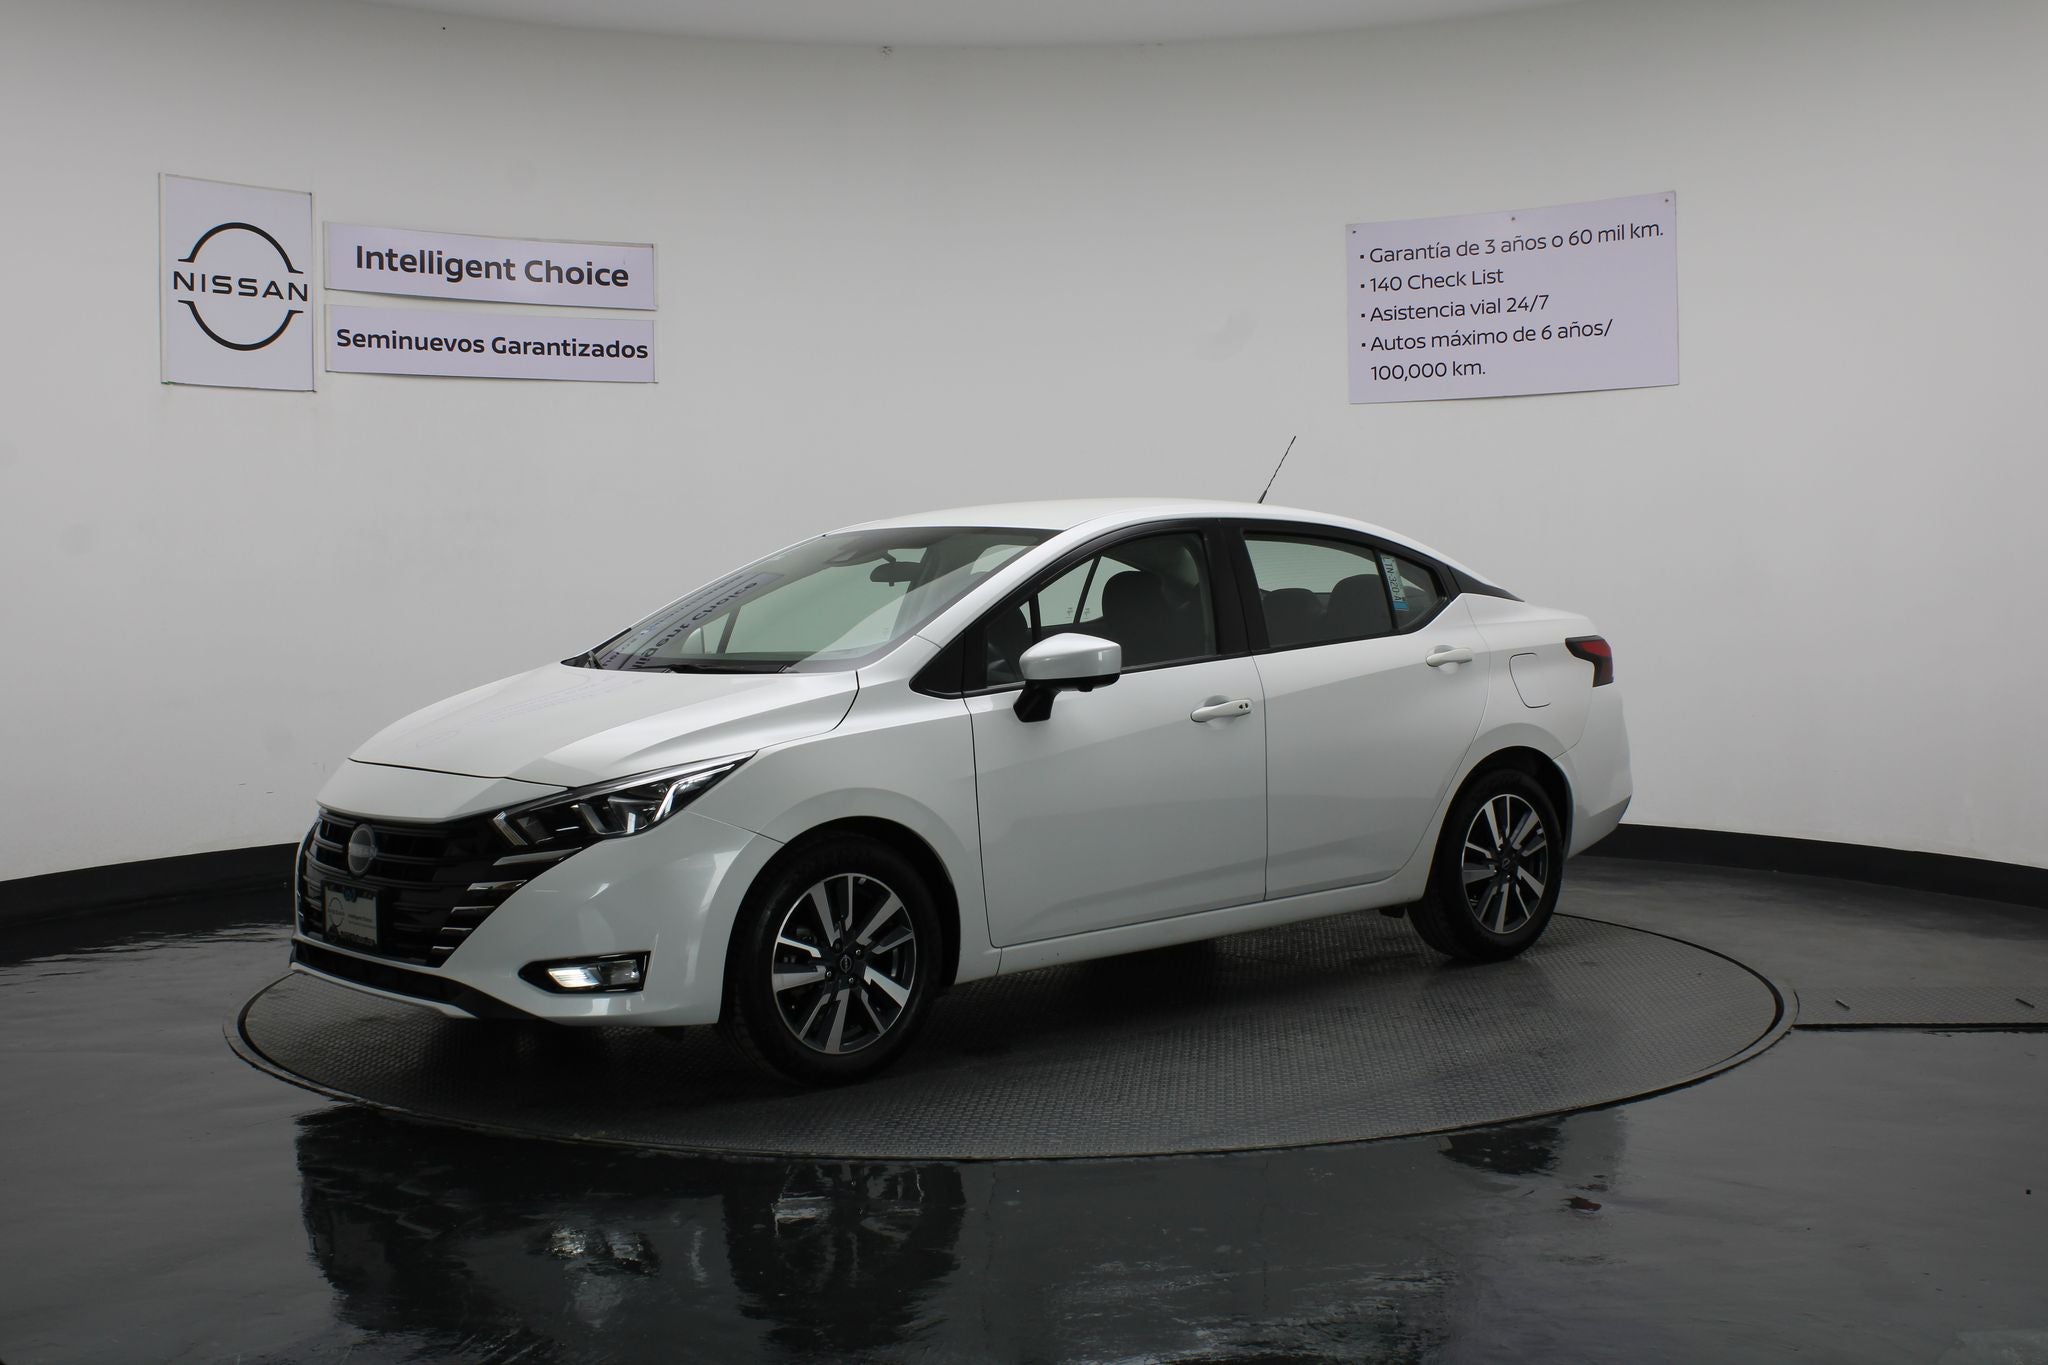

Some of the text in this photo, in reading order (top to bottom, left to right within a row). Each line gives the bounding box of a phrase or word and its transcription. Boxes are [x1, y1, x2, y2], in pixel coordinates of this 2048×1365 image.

[1369, 222, 1664, 264] Garantía de 3 años o 60 mil km.
[356, 245, 629, 288] Intelligent Choice
[1369, 268, 1505, 293] 140 Check List
[173, 270, 308, 302] NISSAN
[1369, 294, 1550, 323] Asistencia vial 24/7
[336, 328, 649, 359] Seminuevos Garantizados
[1370, 318, 1614, 352] Autos máximo de 6 años/
[1370, 360, 1486, 382] 100,000 km.
